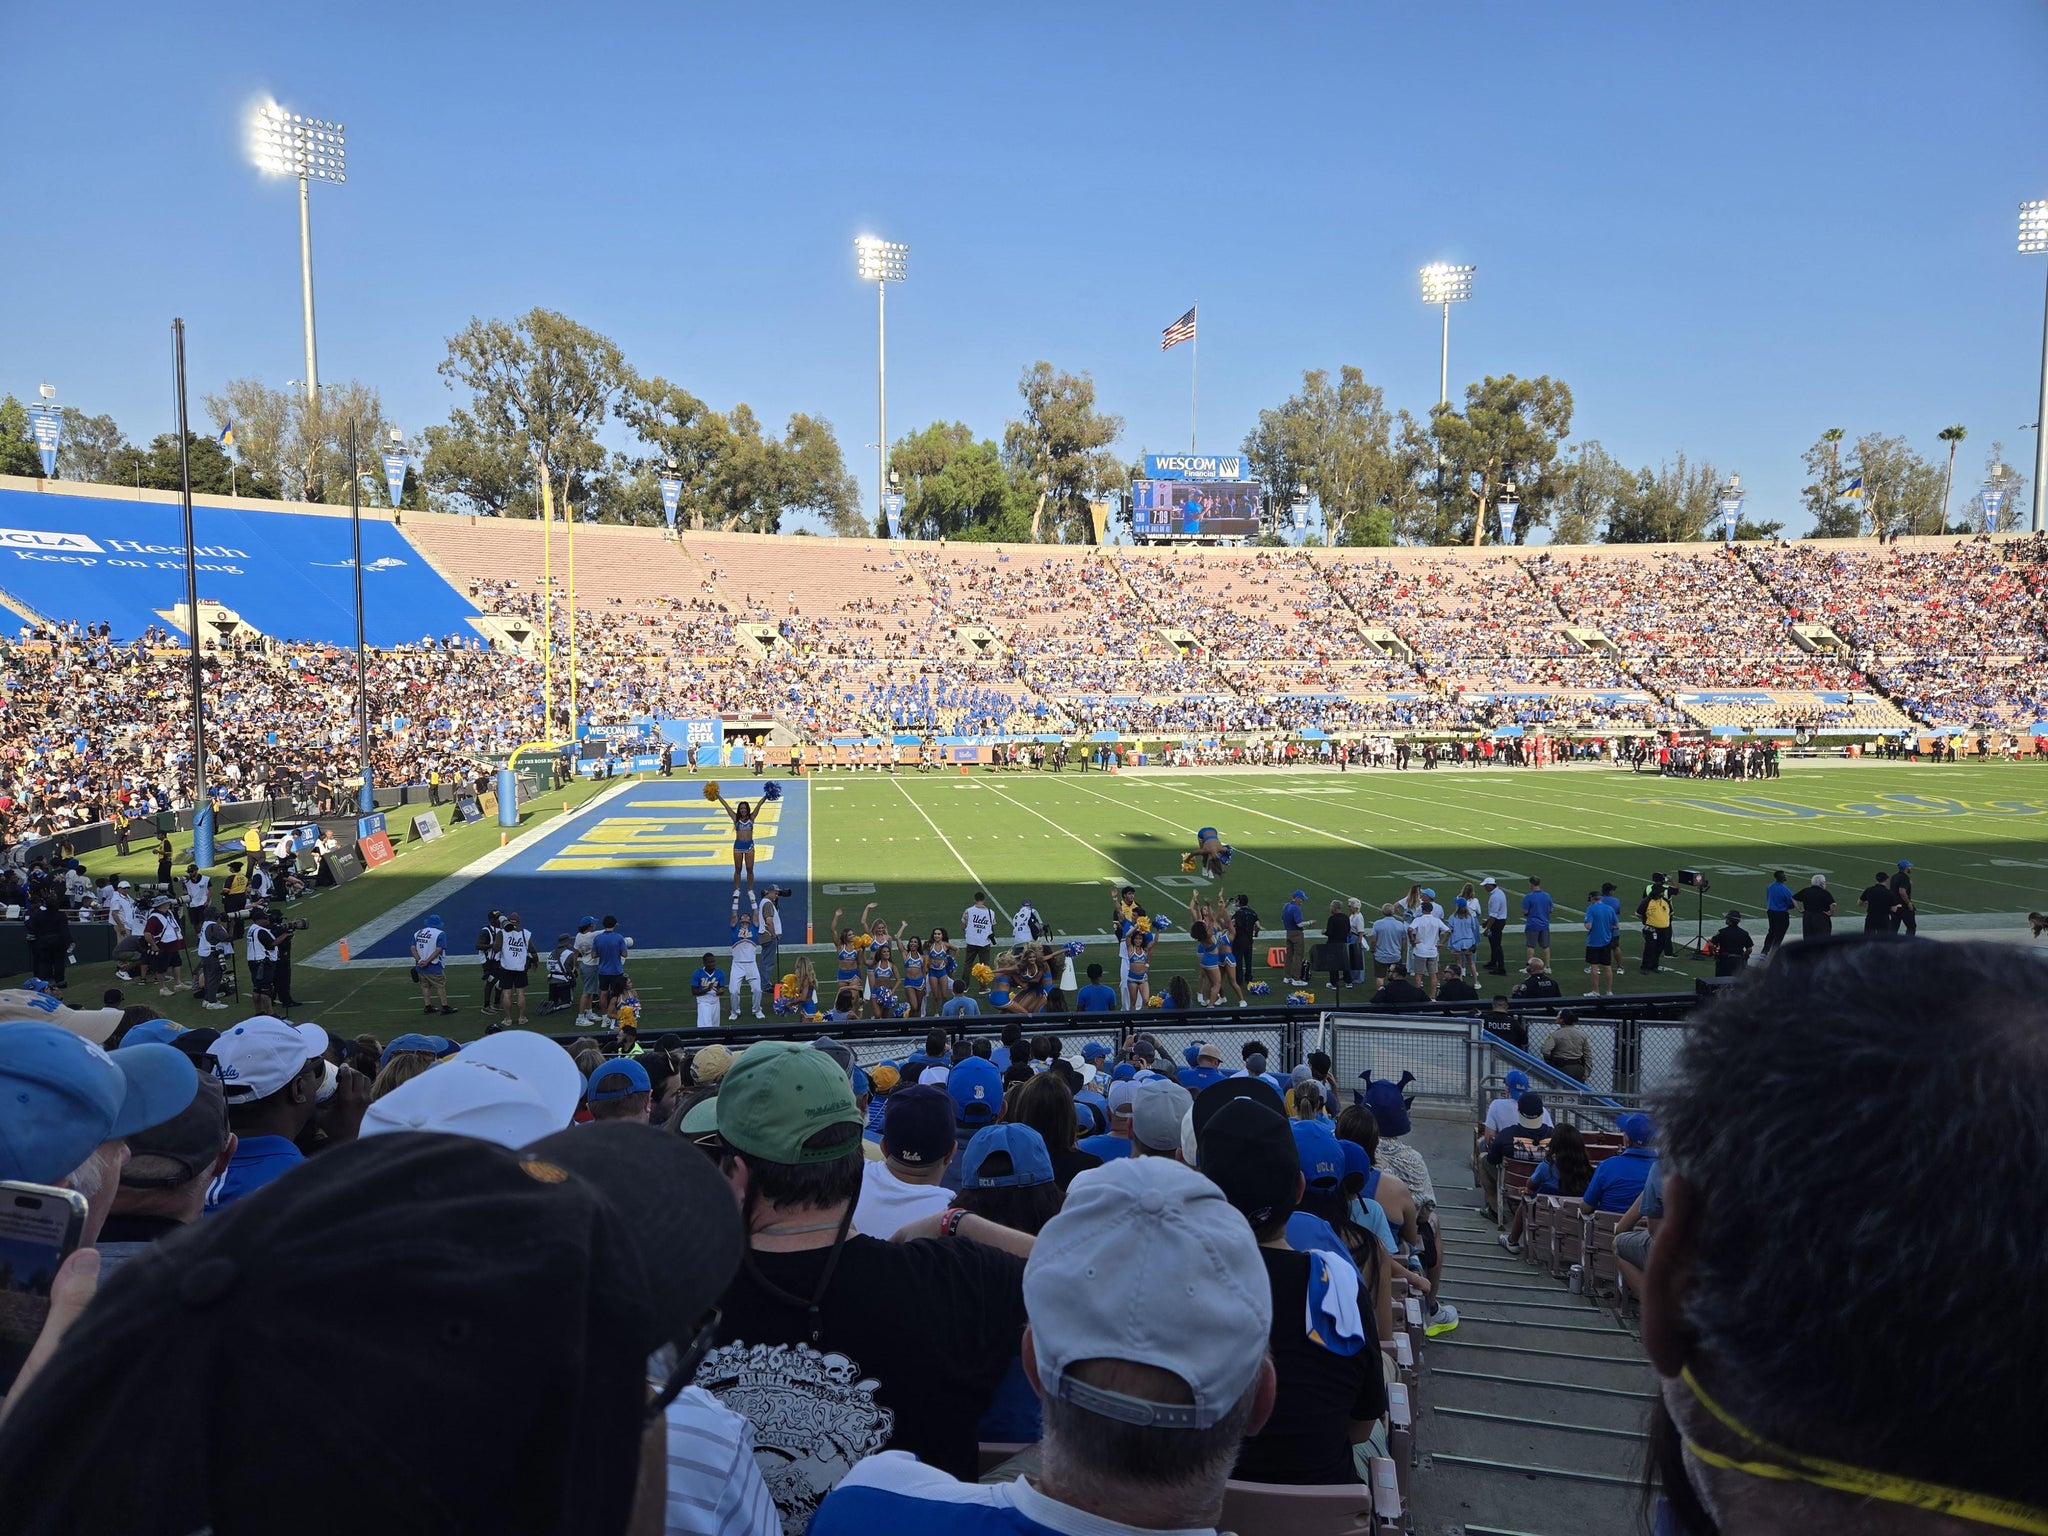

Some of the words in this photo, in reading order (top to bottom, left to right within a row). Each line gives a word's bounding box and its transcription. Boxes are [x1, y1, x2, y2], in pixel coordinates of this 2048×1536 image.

[1155, 457, 1216, 471] WESCOM
[1135, 512, 1145, 523] 2ND
[1153, 510, 1169, 524] 7:09
[0, 533, 84, 548] CLA
[104, 540, 251, 558] Health
[12, 551, 98, 566] Keep
[107, 559, 148, 568] on
[588, 726, 626, 735] WESCOM
[687, 722, 713, 733] SEAT
[686, 732, 715, 744] GEEK
[822, 882, 875, 895] G
[972, 914, 989, 925] Ucla
[416, 929, 432, 939] Ucla
[738, 929, 753, 938] Ucla
[508, 936, 524, 948] Ucla
[1273, 949, 1286, 965] 10
[1488, 1021, 1512, 1031] POLICE
[214, 1064, 240, 1080] Ucla
[973, 1085, 985, 1099] B
[902, 1150, 922, 1161] Ucla
[1315, 1161, 1335, 1173] UCLA
[978, 1178, 996, 1187] UCLA
[749, 1344, 806, 1371] 26th
[738, 1372, 794, 1389] ANNUAL
[756, 1431, 824, 1451] CONTEST
